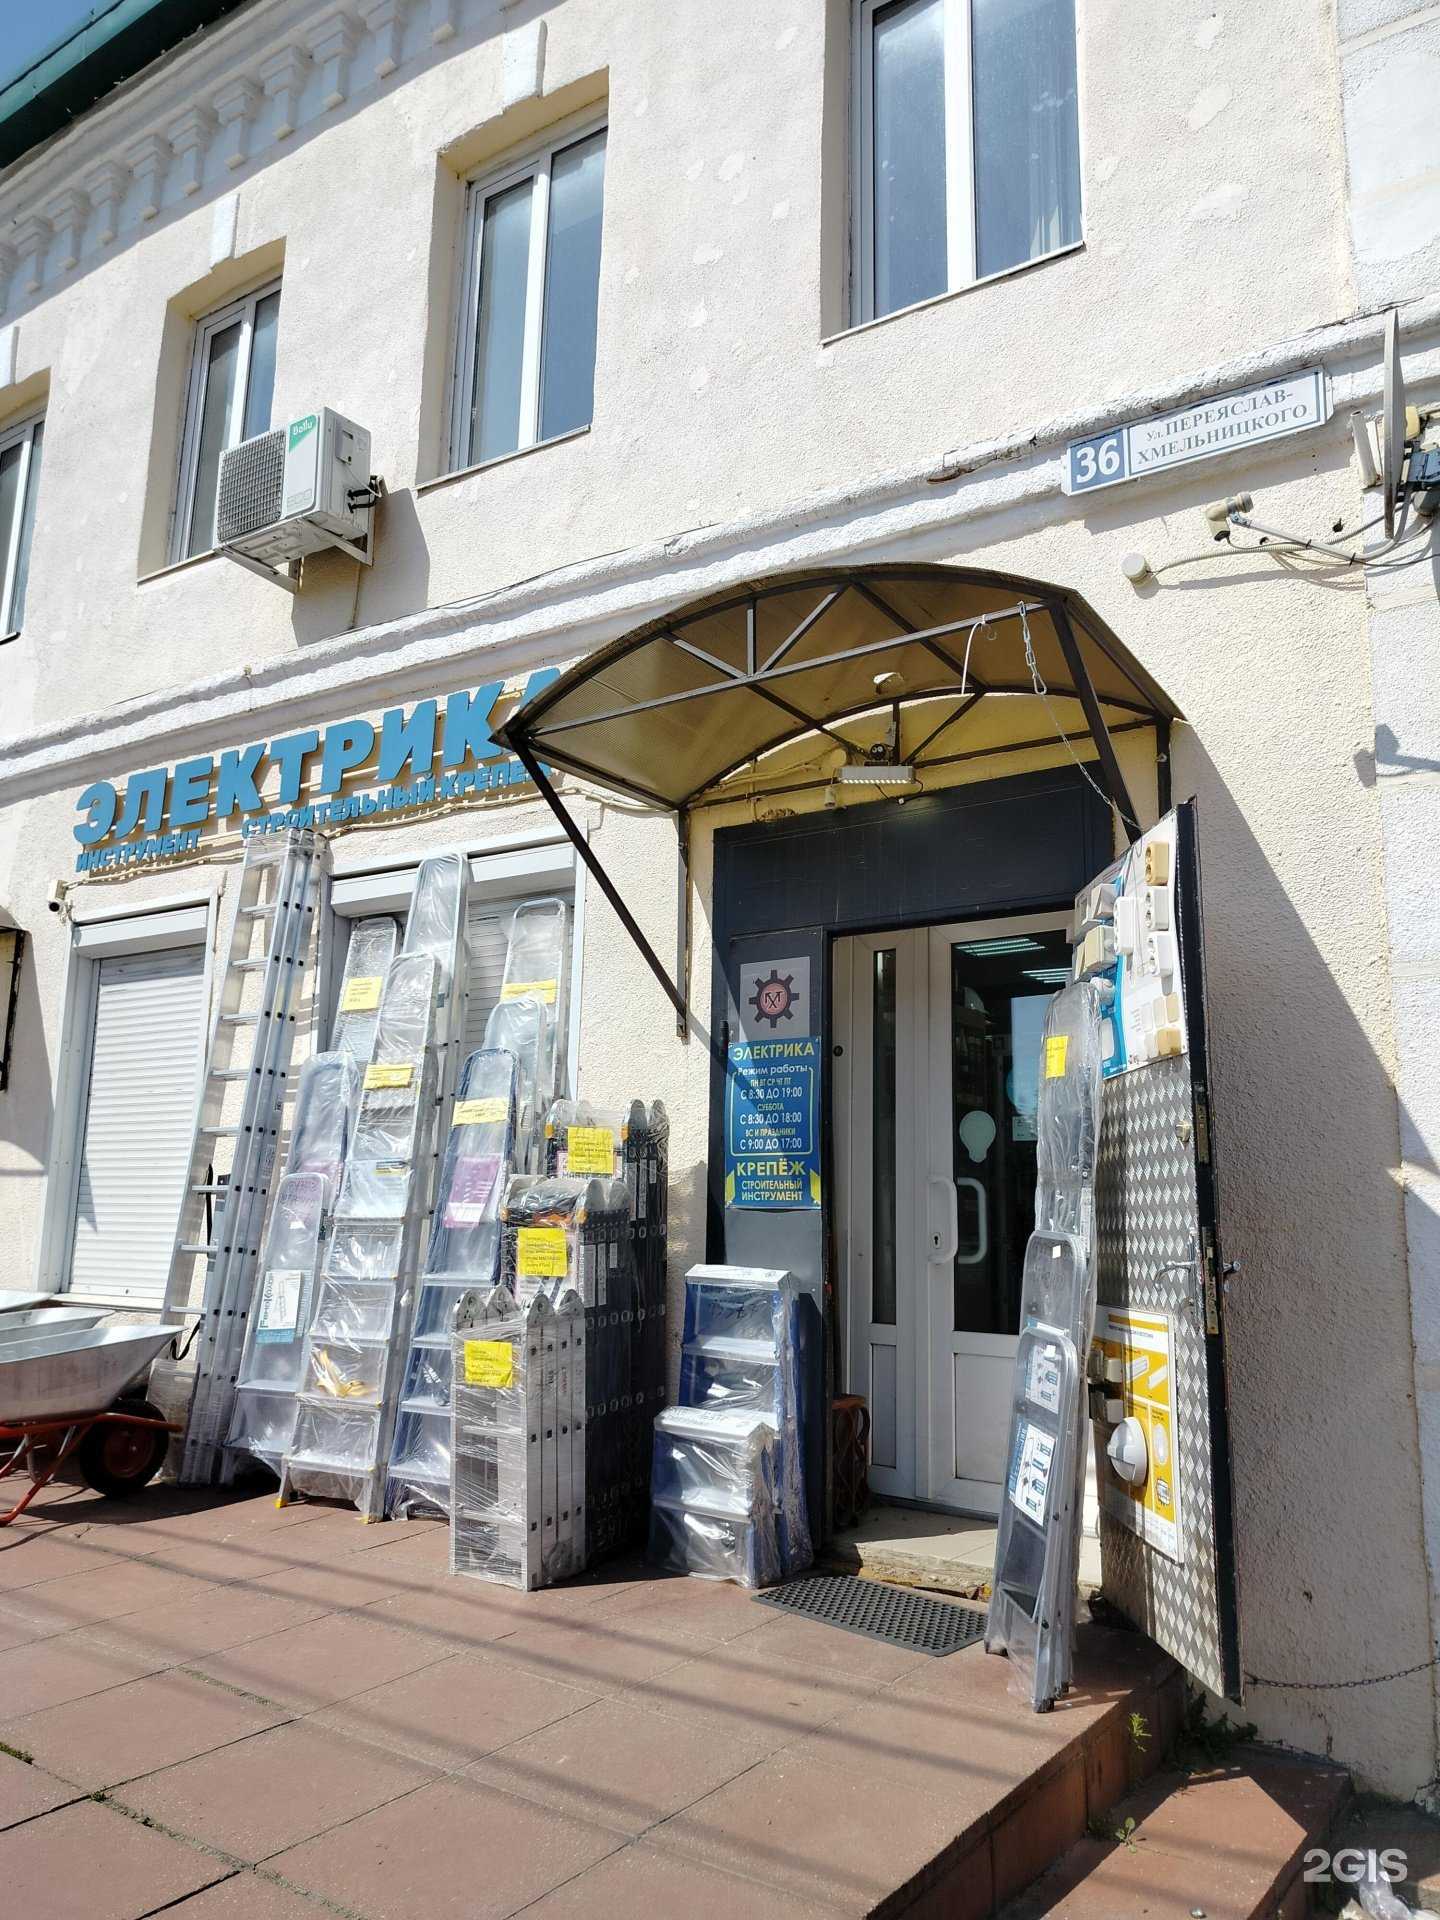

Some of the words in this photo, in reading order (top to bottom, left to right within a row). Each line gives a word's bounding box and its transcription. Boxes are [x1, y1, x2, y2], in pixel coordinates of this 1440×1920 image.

[1166, 389, 1293, 435] ПЕРЕЯСЛАВ-
[1138, 404, 1307, 464] ХМЕЛЬНИЦКОГО
[1076, 438, 1121, 484] 36
[242, 772, 436, 838] СТРОИТЕЛЬНЫЙ
[75, 829, 202, 872] ИНСТРУМЕНТ
[733, 1042, 815, 1061] ЭЛЕКТРИКА
[737, 1066, 769, 1076] Режим
[770, 1063, 808, 1076] работы
[740, 1089, 748, 1101] С
[748, 1088, 765, 1100] 8:30
[766, 1087, 780, 1100] ДО
[782, 1086, 803, 1098] 19:00
[757, 1102, 785, 1112] СУББОТА
[739, 1114, 747, 1125] С
[748, 1113, 764, 1125] 8:30
[765, 1113, 779, 1125] ДО
[781, 1111, 802, 1123] 18:00
[760, 1127, 796, 1137] ПРАЗДНИКИ
[739, 1139, 747, 1150] С
[748, 1138, 764, 1150] 9:00
[765, 1138, 779, 1150] ДО
[781, 1137, 802, 1149] 17:00
[736, 1158, 807, 1177] КРЕПЁЖ
[741, 1178, 803, 1190] СТРОИТЕЛЬНЫЙ
[741, 1191, 804, 1201] ИНСТРУМЕНТ
